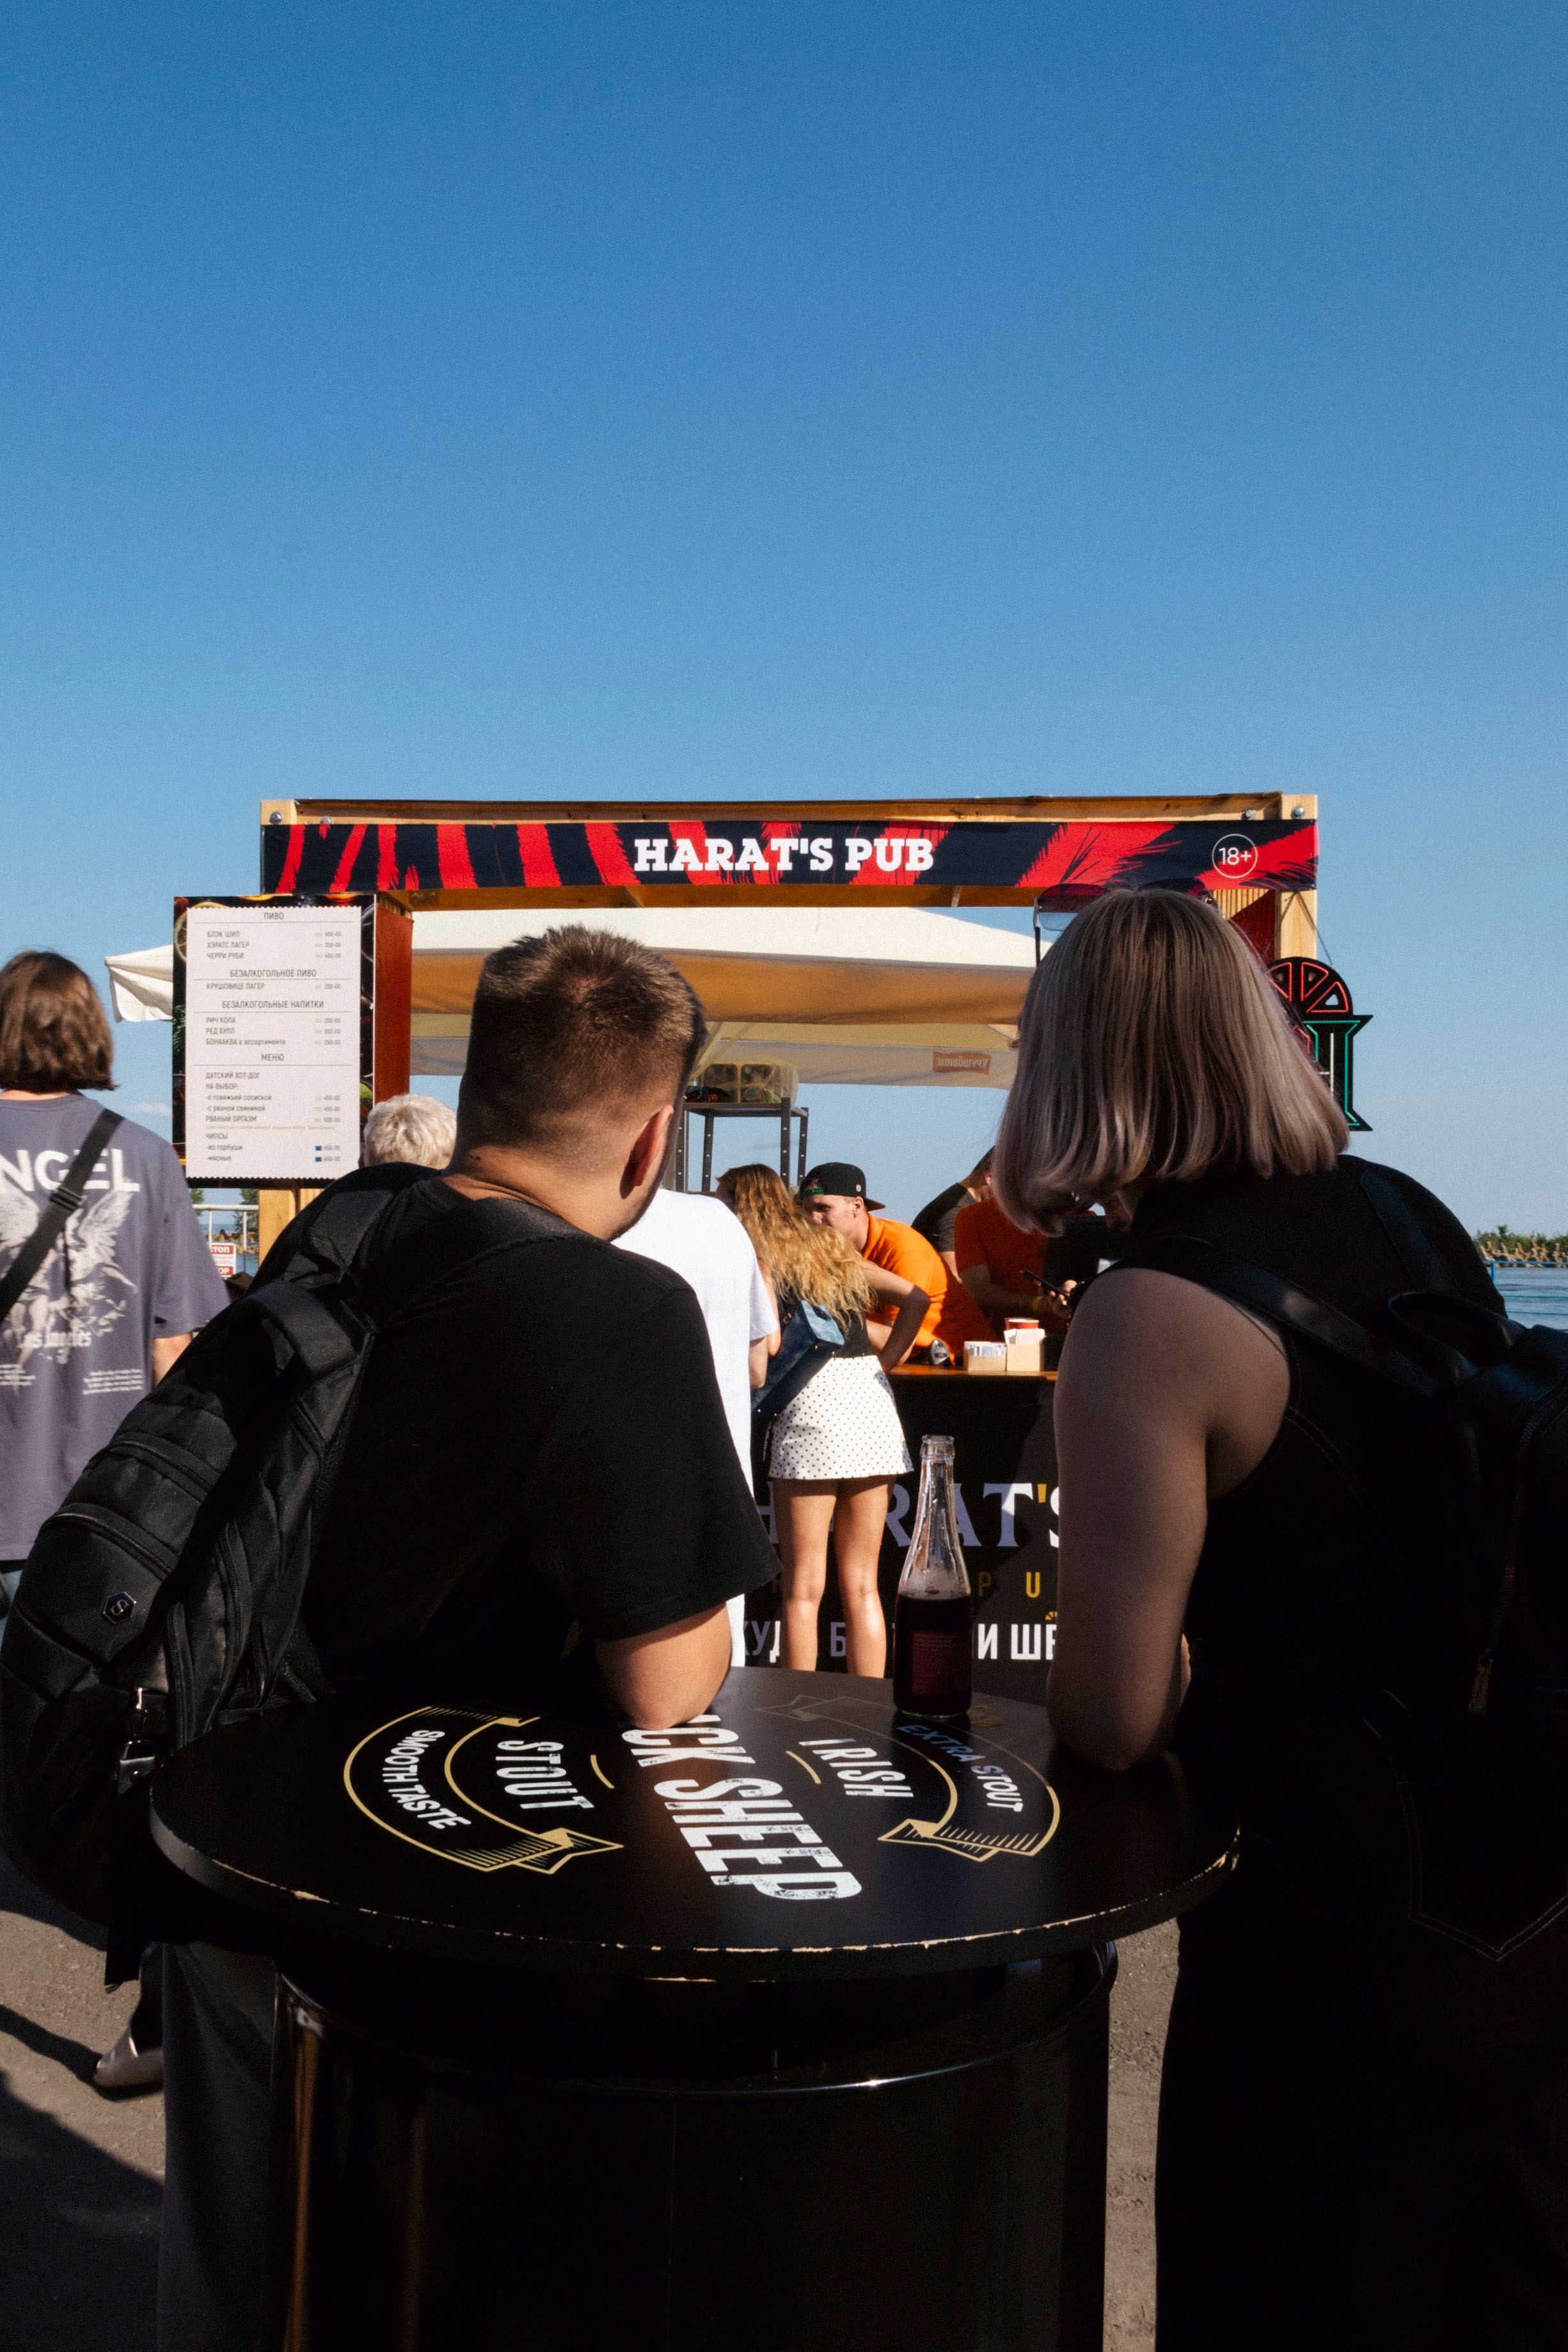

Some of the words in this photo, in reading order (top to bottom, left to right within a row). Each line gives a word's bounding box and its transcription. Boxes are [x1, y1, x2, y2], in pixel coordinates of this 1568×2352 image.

[634, 838, 833, 871] HARAT'S
[845, 838, 933, 871] PUB
[1219, 848, 1251, 865] 18+
[230, 969, 294, 978] БЕЗАЛКОГОЛЬНОЕ
[296, 969, 317, 978] ПИВО
[222, 1001, 289, 1009] БЕЗАЛКОГОЛЬНЫЕ
[290, 1001, 324, 1009] НАПИТКИ
[382, 1729, 445, 1783] SMOOTH
[495, 1740, 595, 1809] STOUT
[798, 1738, 914, 1798] IRISH
[897, 1724, 986, 1763] EXTRA
[970, 1765, 1023, 1813] STOUT
[388, 1784, 471, 1829] TASTE
[653, 1777, 862, 1900] SHEEP
